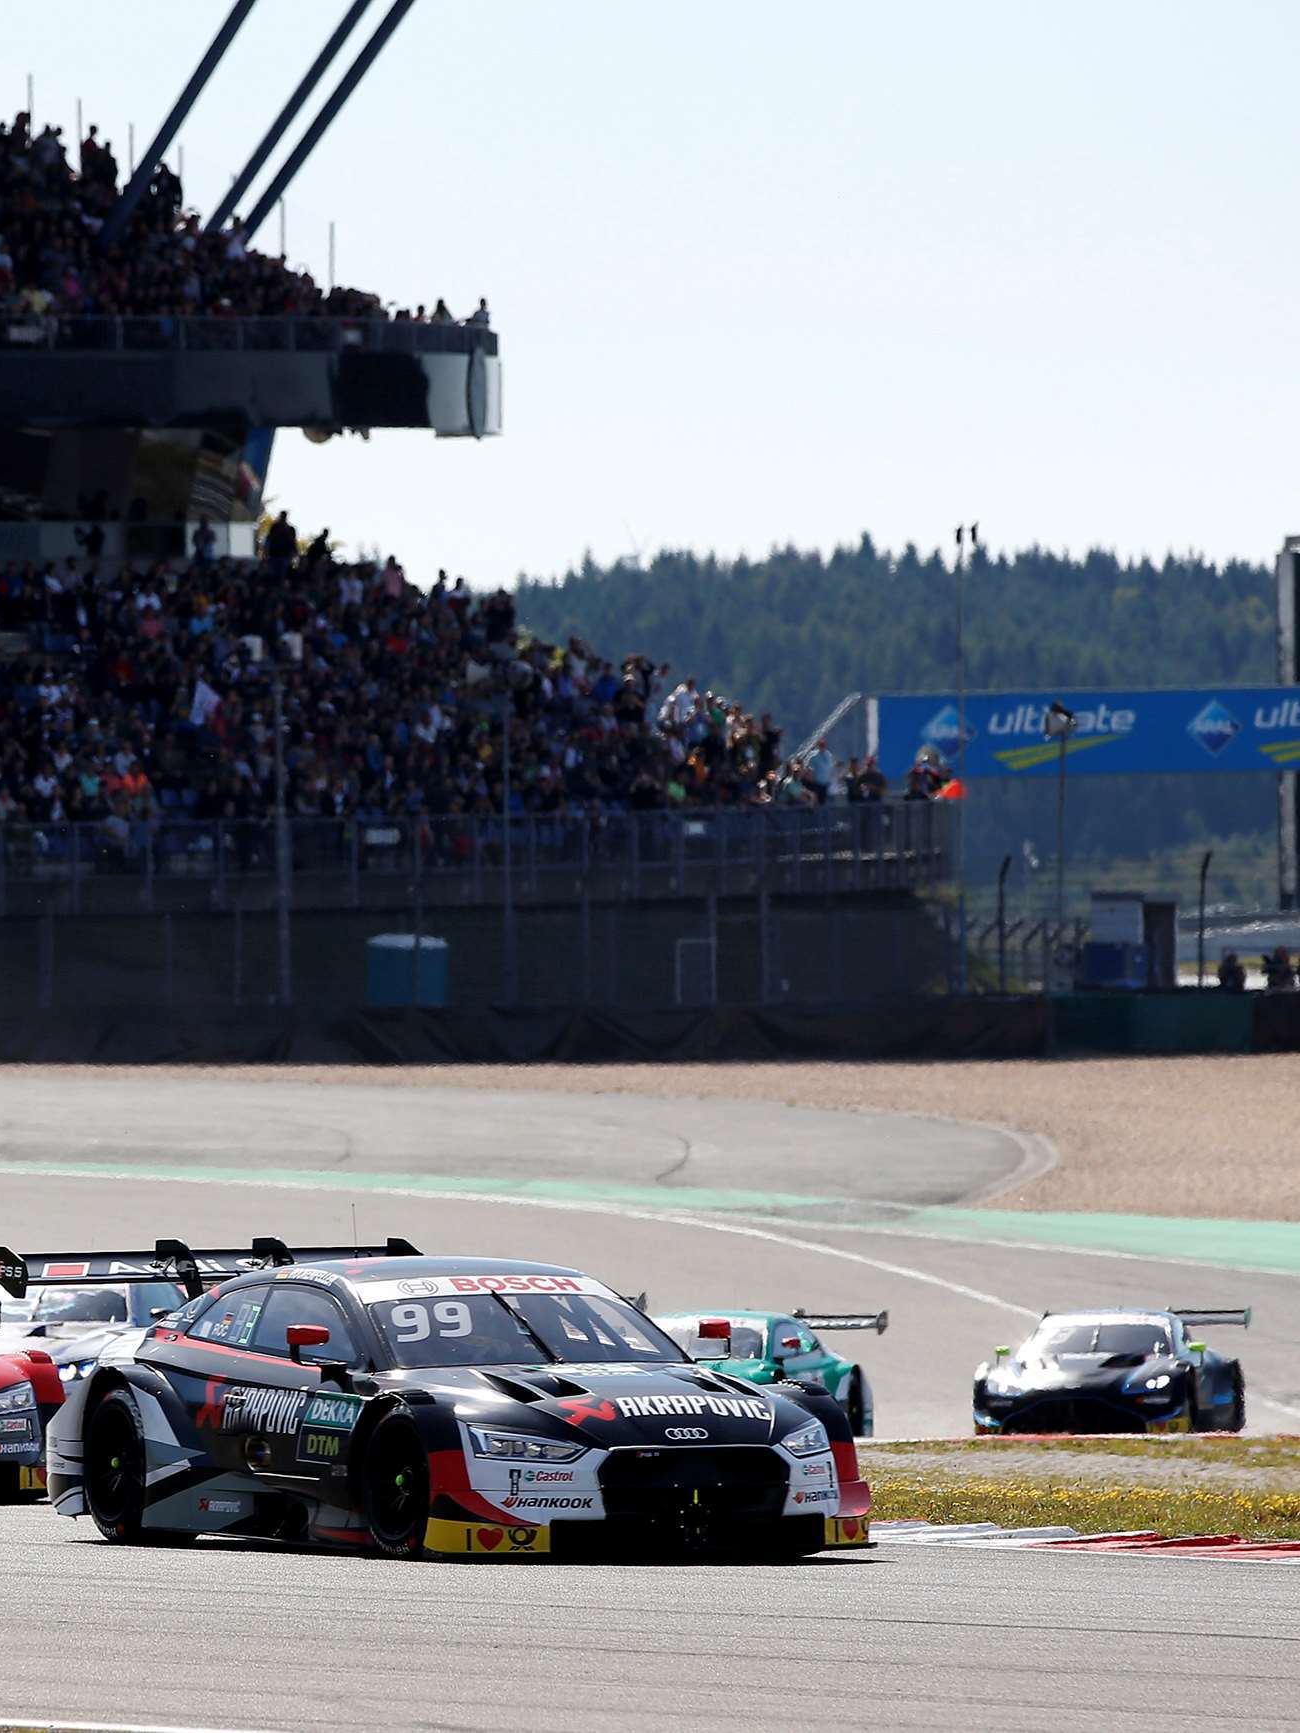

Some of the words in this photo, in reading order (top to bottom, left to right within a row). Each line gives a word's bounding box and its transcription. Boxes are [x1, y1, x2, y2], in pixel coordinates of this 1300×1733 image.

[987, 704, 1137, 735] ultiate
[448, 1277, 583, 1292] BOSCH
[390, 1301, 473, 1343] 99
[311, 1398, 355, 1424] DEKRA
[307, 1434, 340, 1457] DTM
[535, 1470, 574, 1482] Castrol
